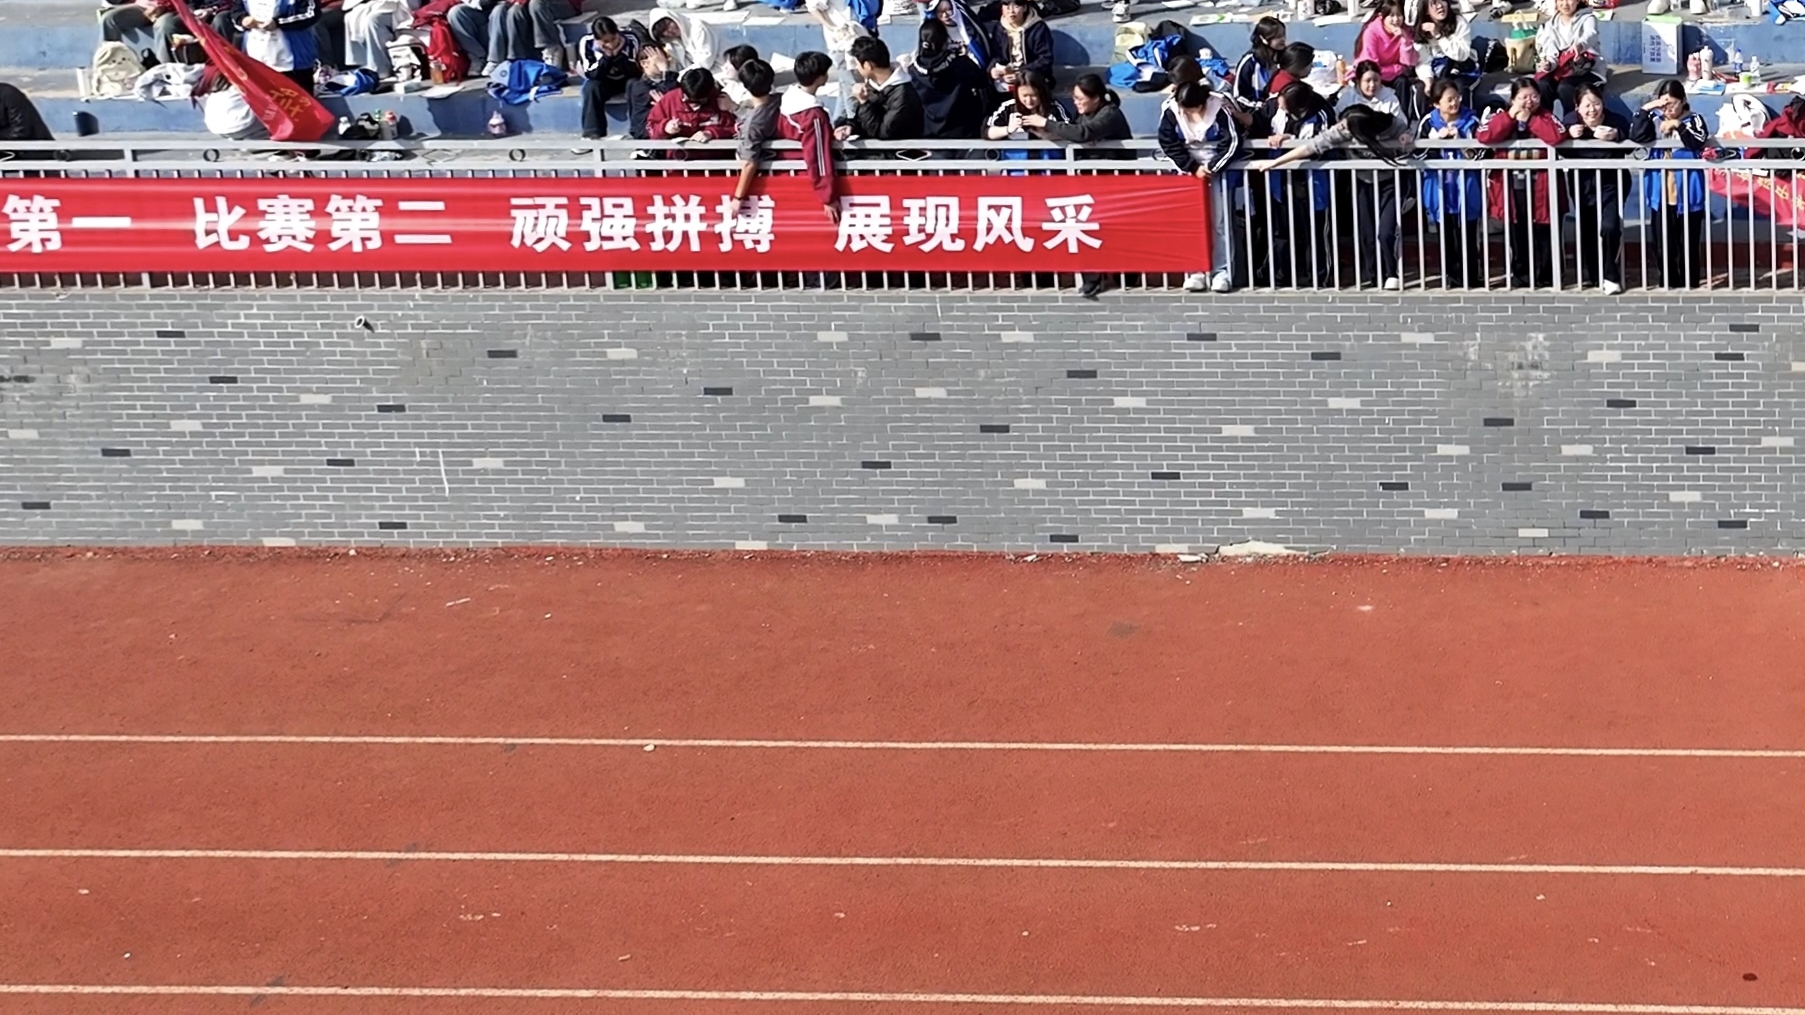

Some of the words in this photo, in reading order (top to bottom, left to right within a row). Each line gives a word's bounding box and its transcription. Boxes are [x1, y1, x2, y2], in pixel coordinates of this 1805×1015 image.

[1, 194, 132, 253] 第一
[193, 194, 454, 253] 比赛第二
[509, 194, 775, 253] 顽强拼搏
[834, 194, 1103, 253] 展现风采
